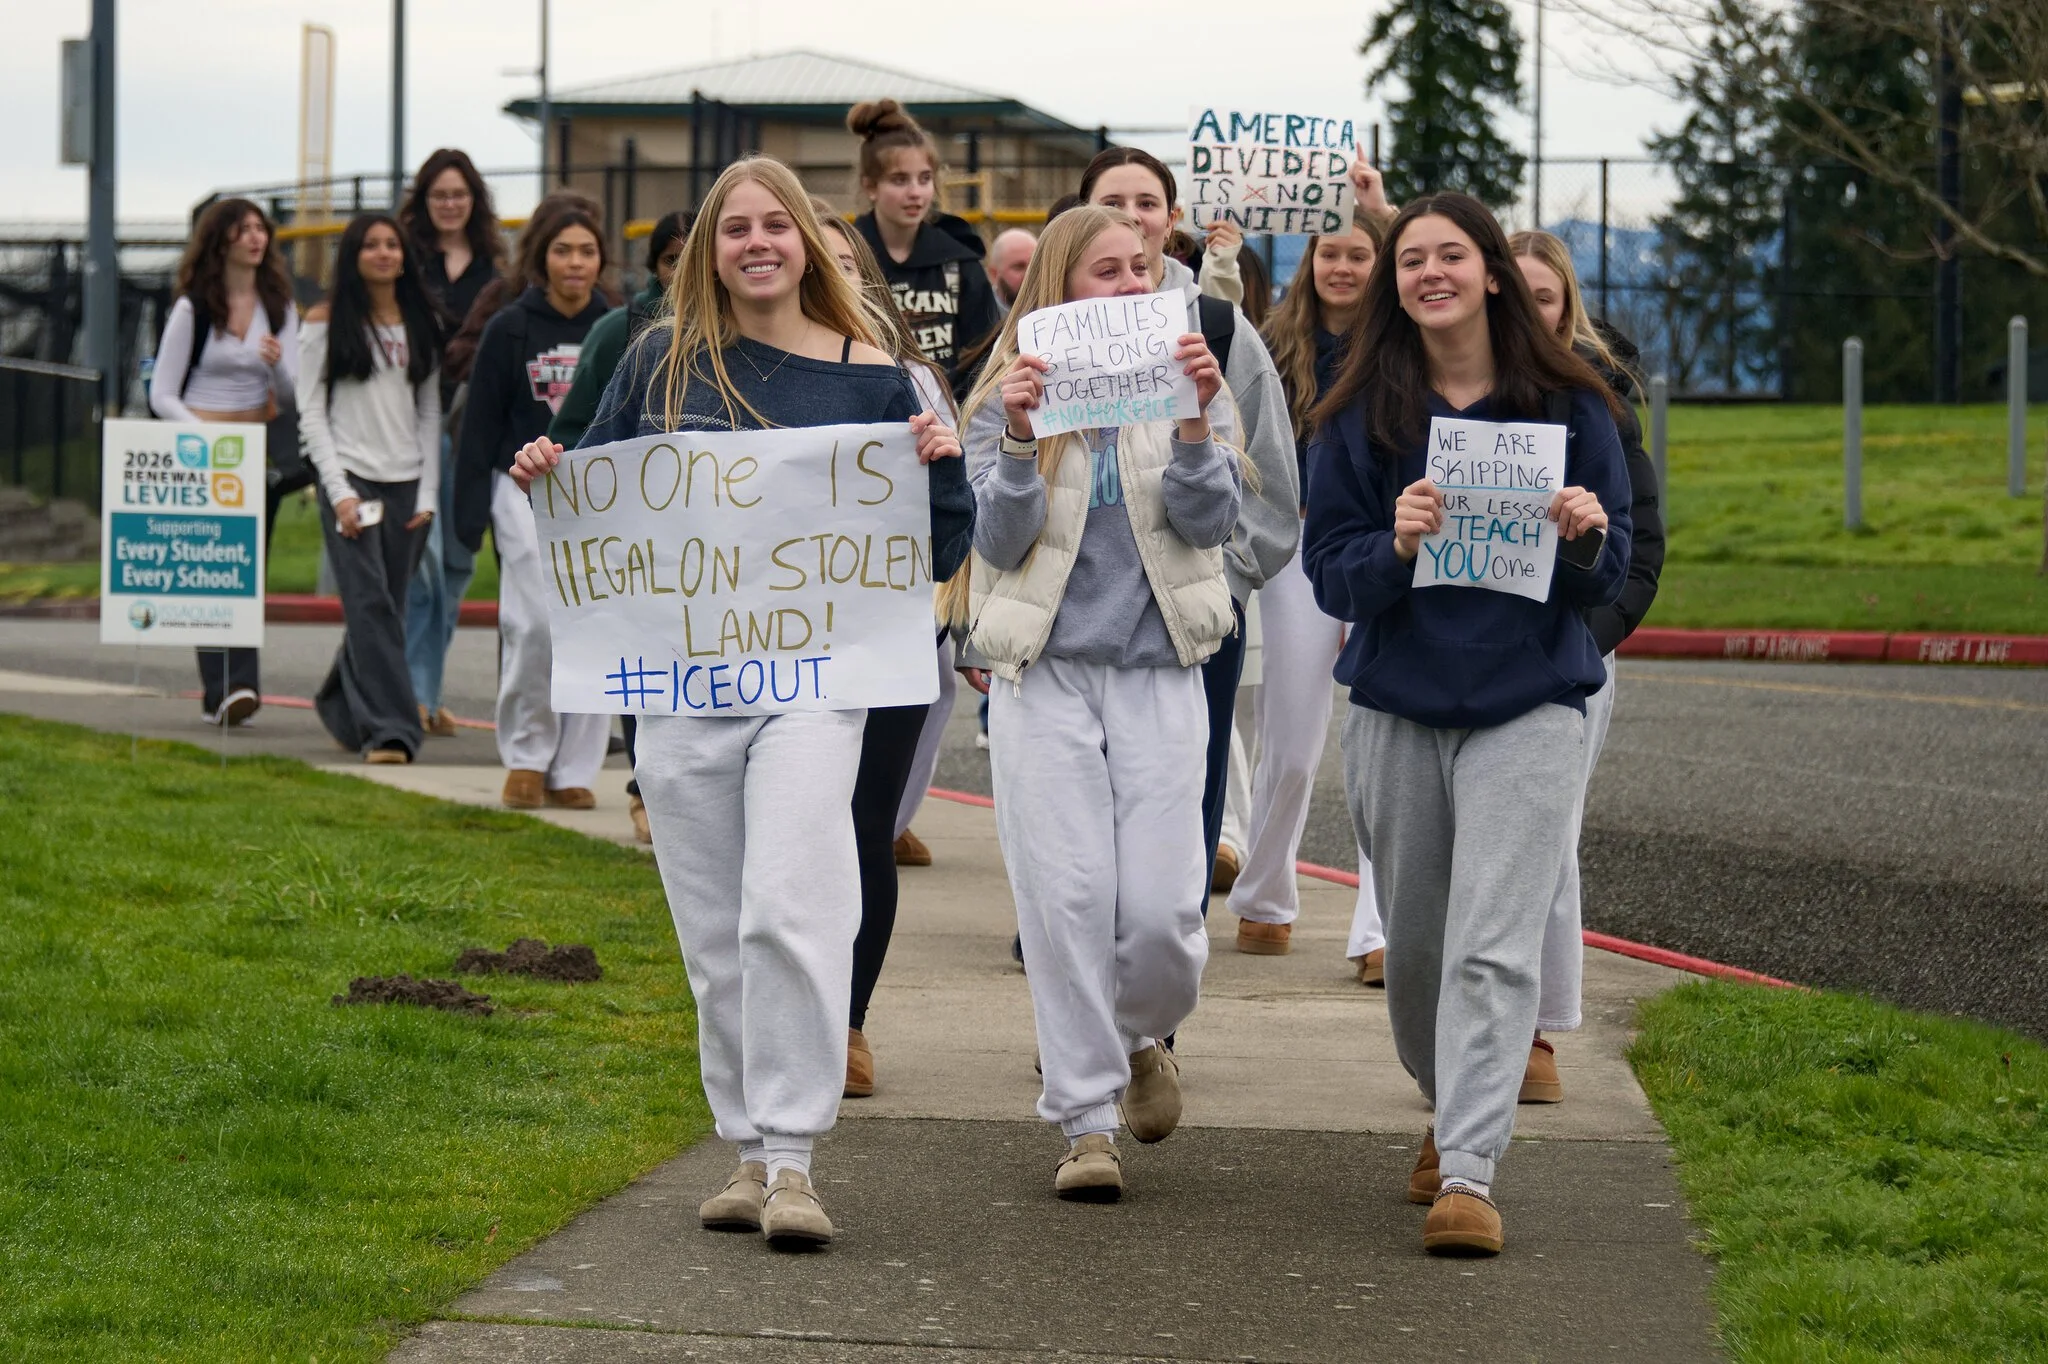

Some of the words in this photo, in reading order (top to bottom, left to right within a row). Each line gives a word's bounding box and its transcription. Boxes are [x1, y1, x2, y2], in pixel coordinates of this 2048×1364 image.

[1189, 108, 1355, 150] AMERICA
[1192, 145, 1348, 179] DIVIDED
[1192, 178, 1235, 205] IS
[1277, 182, 1347, 206] NOT
[1192, 206, 1343, 234] UNITED
[1032, 296, 1168, 350] FAMILIES
[1037, 333, 1169, 377] BELONG
[1042, 365, 1174, 406] TOGETHER
[1437, 427, 1467, 451] WE
[1493, 432, 1537, 455] ARE
[123, 451, 174, 468] 2026
[1431, 455, 1554, 490] SKIPPING
[124, 470, 210, 485] RENEWAL
[546, 456, 618, 519] NO
[829, 440, 894, 508] IS
[123, 484, 210, 507] LEVIES
[1442, 493, 1471, 512] UR
[146, 518, 222, 540] Supporting
[1449, 514, 1540, 548] TEACH
[116, 536, 169, 566] Every
[171, 539, 251, 566] Student,
[769, 533, 932, 592] STOLEN
[1423, 538, 1491, 582] YOU
[122, 563, 175, 593] Every
[177, 566, 246, 590] School.
[683, 601, 834, 658] LAND!
